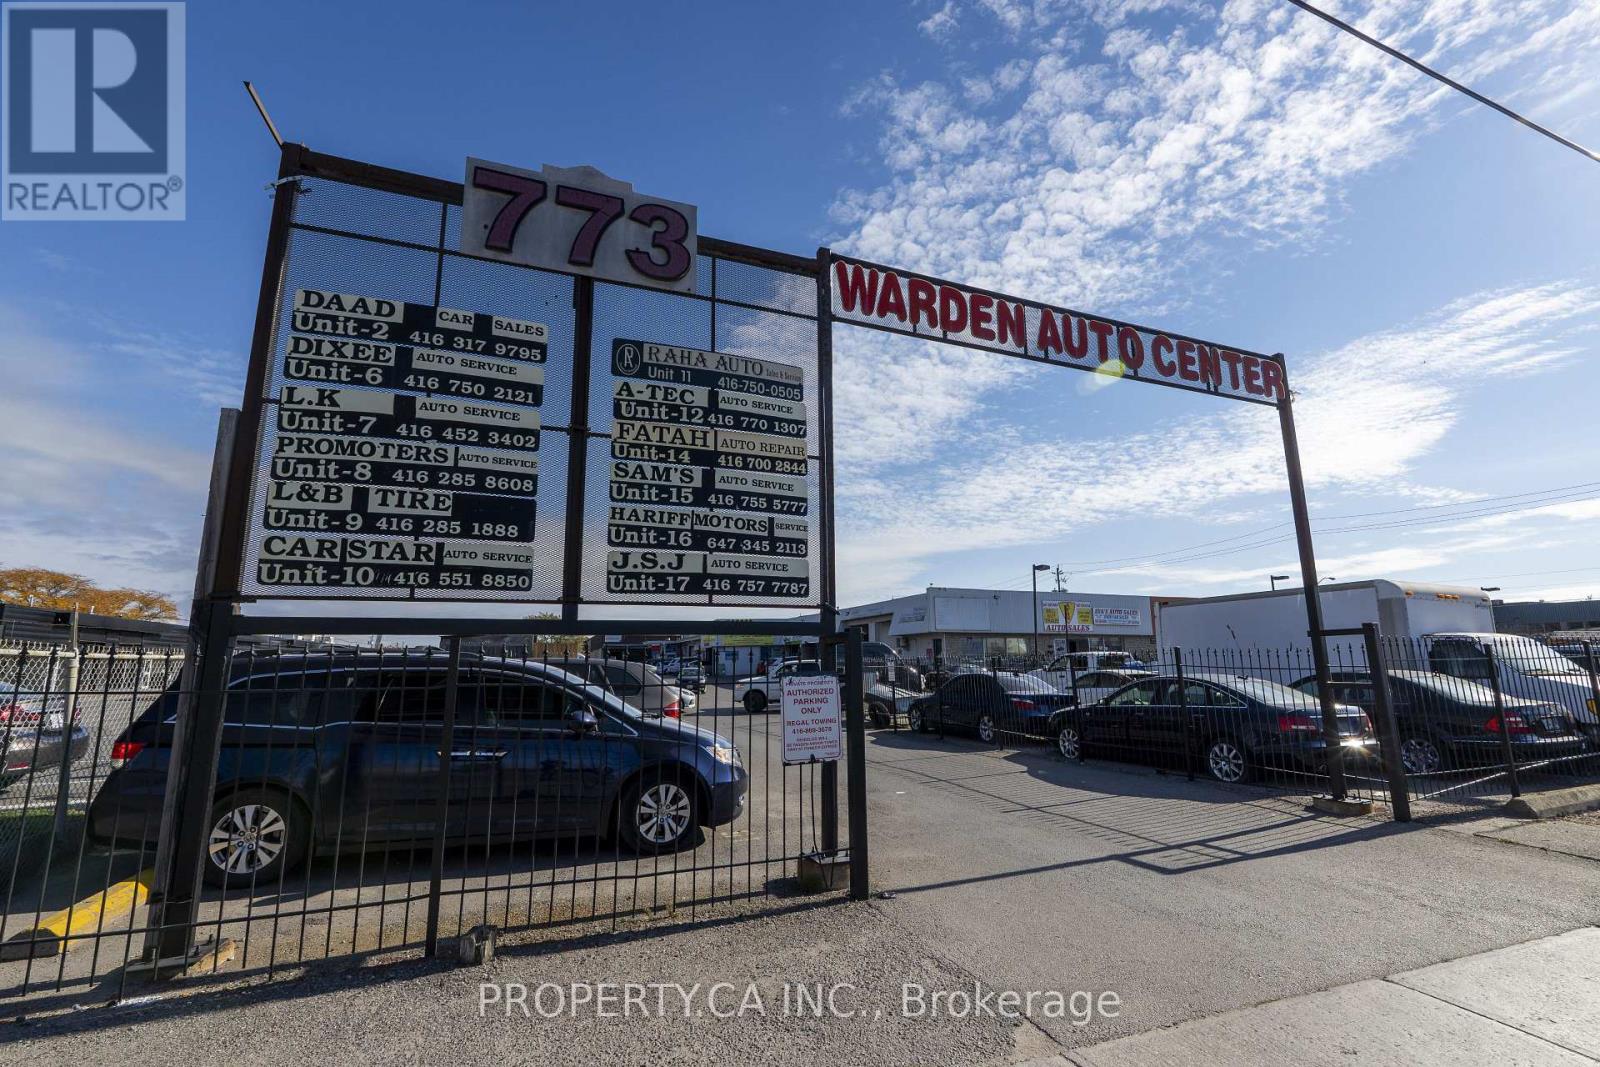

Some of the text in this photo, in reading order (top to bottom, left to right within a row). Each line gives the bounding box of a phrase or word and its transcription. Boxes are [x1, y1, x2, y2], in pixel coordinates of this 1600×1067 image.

[473, 166, 691, 281] 773
[301, 290, 544, 336] DAAD CAR SALES
[835, 260, 1025, 348] WARDEN
[295, 311, 541, 360] Unit-2 416 317 9795
[290, 337, 517, 375] DIXEE AUTO SERVICE
[649, 346, 709, 367] RAHA
[716, 356, 763, 376] AUTO
[1037, 308, 1286, 399] AUTO CENTER
[288, 359, 534, 403] Unit-6 416 750 2121
[649, 367, 801, 400] Unit 11 416-750-0505
[283, 387, 520, 421] L.K AUTO SERVICE
[616, 382, 793, 414] A-TEC AUTO SERVICE
[280, 412, 535, 447] Unit-7 416 452 3402
[620, 400, 806, 435] Unit-12 416 770 1307
[276, 437, 537, 468] PROMOTERS AUTO SERVICE
[617, 423, 805, 456] FATAH AUTO REPAIR
[614, 443, 806, 473] Unit-14 416 700 2844
[274, 458, 533, 491] Unit-8 416 285 8608
[614, 462, 794, 491] SAM'S AUTO SERVICE
[272, 482, 452, 511] L&B TIRE
[611, 483, 806, 512] Unit-15 416 755 5777
[267, 510, 518, 537] Unit-9 416 285 1888
[609, 507, 808, 533] HARIFF MOTORS SERVICE
[264, 536, 533, 563] CAR STAR AUTO SERVICE
[610, 527, 806, 554] Unit-16 647 345 2113
[259, 565, 530, 588] Unit-10 416 551 8850
[612, 554, 788, 571] J.S.J AUTO SERVICE
[609, 575, 808, 594] Unit-17 416 757 7787
[787, 688, 834, 696] AUTHORIZED
[794, 697, 828, 705] PARKING
